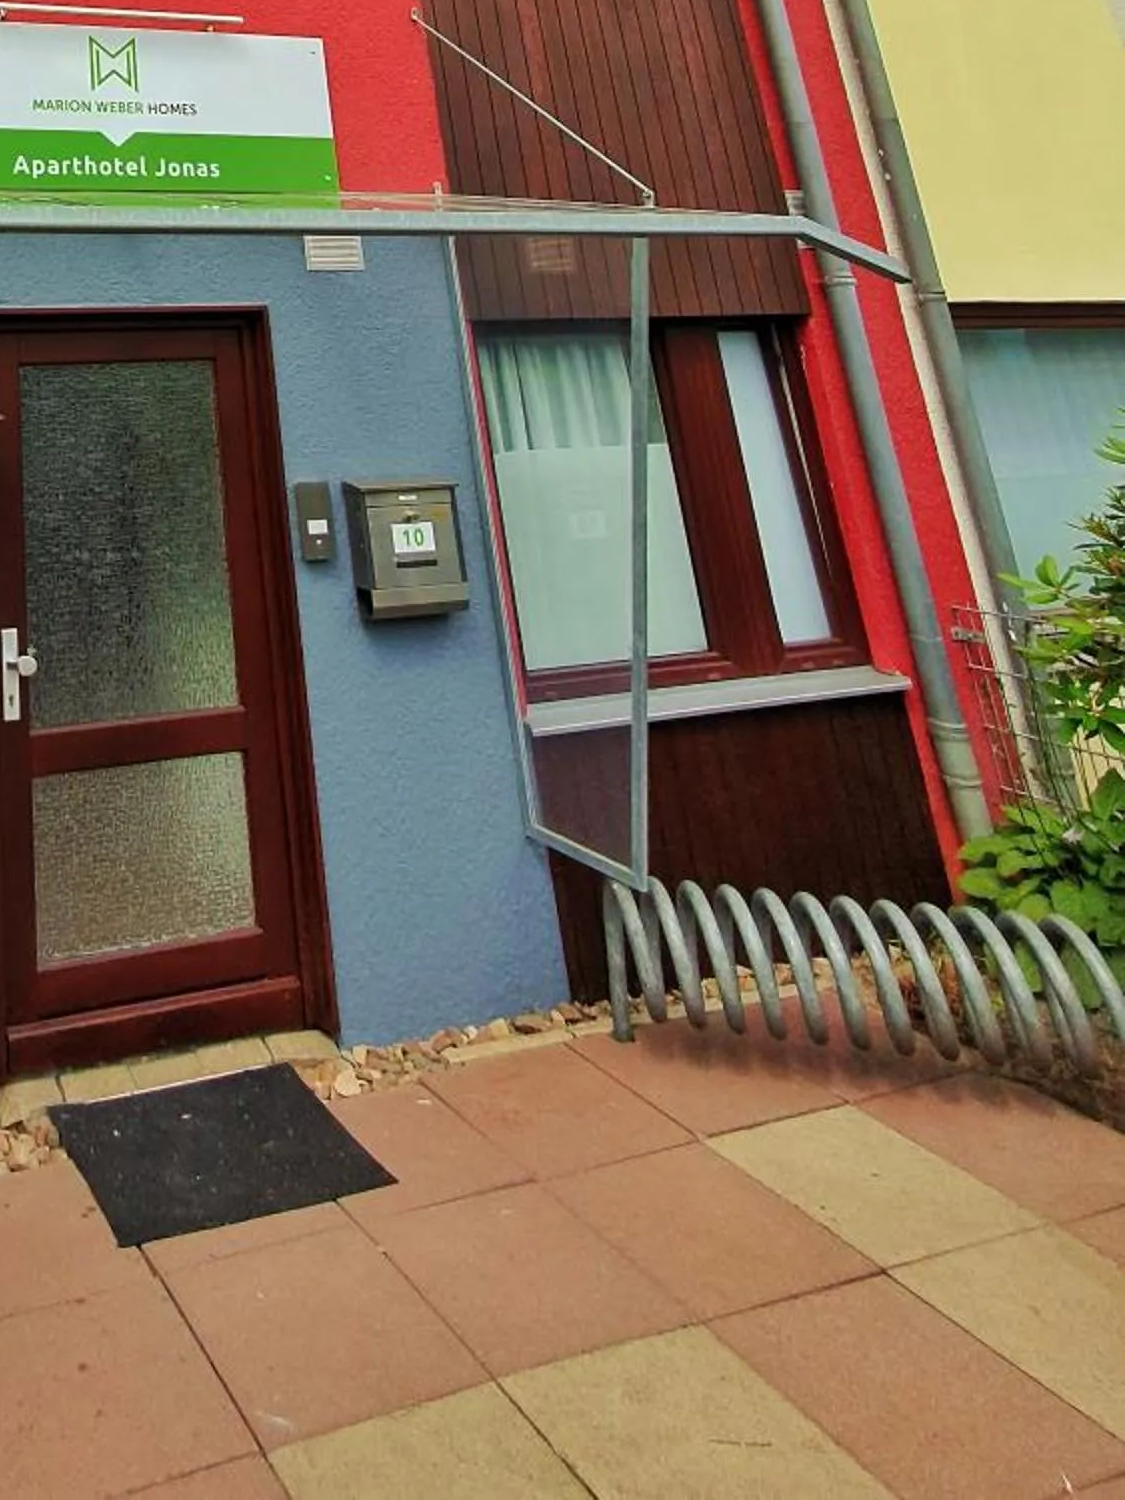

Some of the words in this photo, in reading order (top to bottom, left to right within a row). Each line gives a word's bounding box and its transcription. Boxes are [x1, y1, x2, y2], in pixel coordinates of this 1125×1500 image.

[32, 99, 92, 113] MARION
[96, 101, 144, 115] WEBER
[148, 103, 198, 116] HOMES
[13, 155, 148, 179] Aparthotel
[154, 158, 220, 177] Jonas
[402, 527, 425, 547] 10
